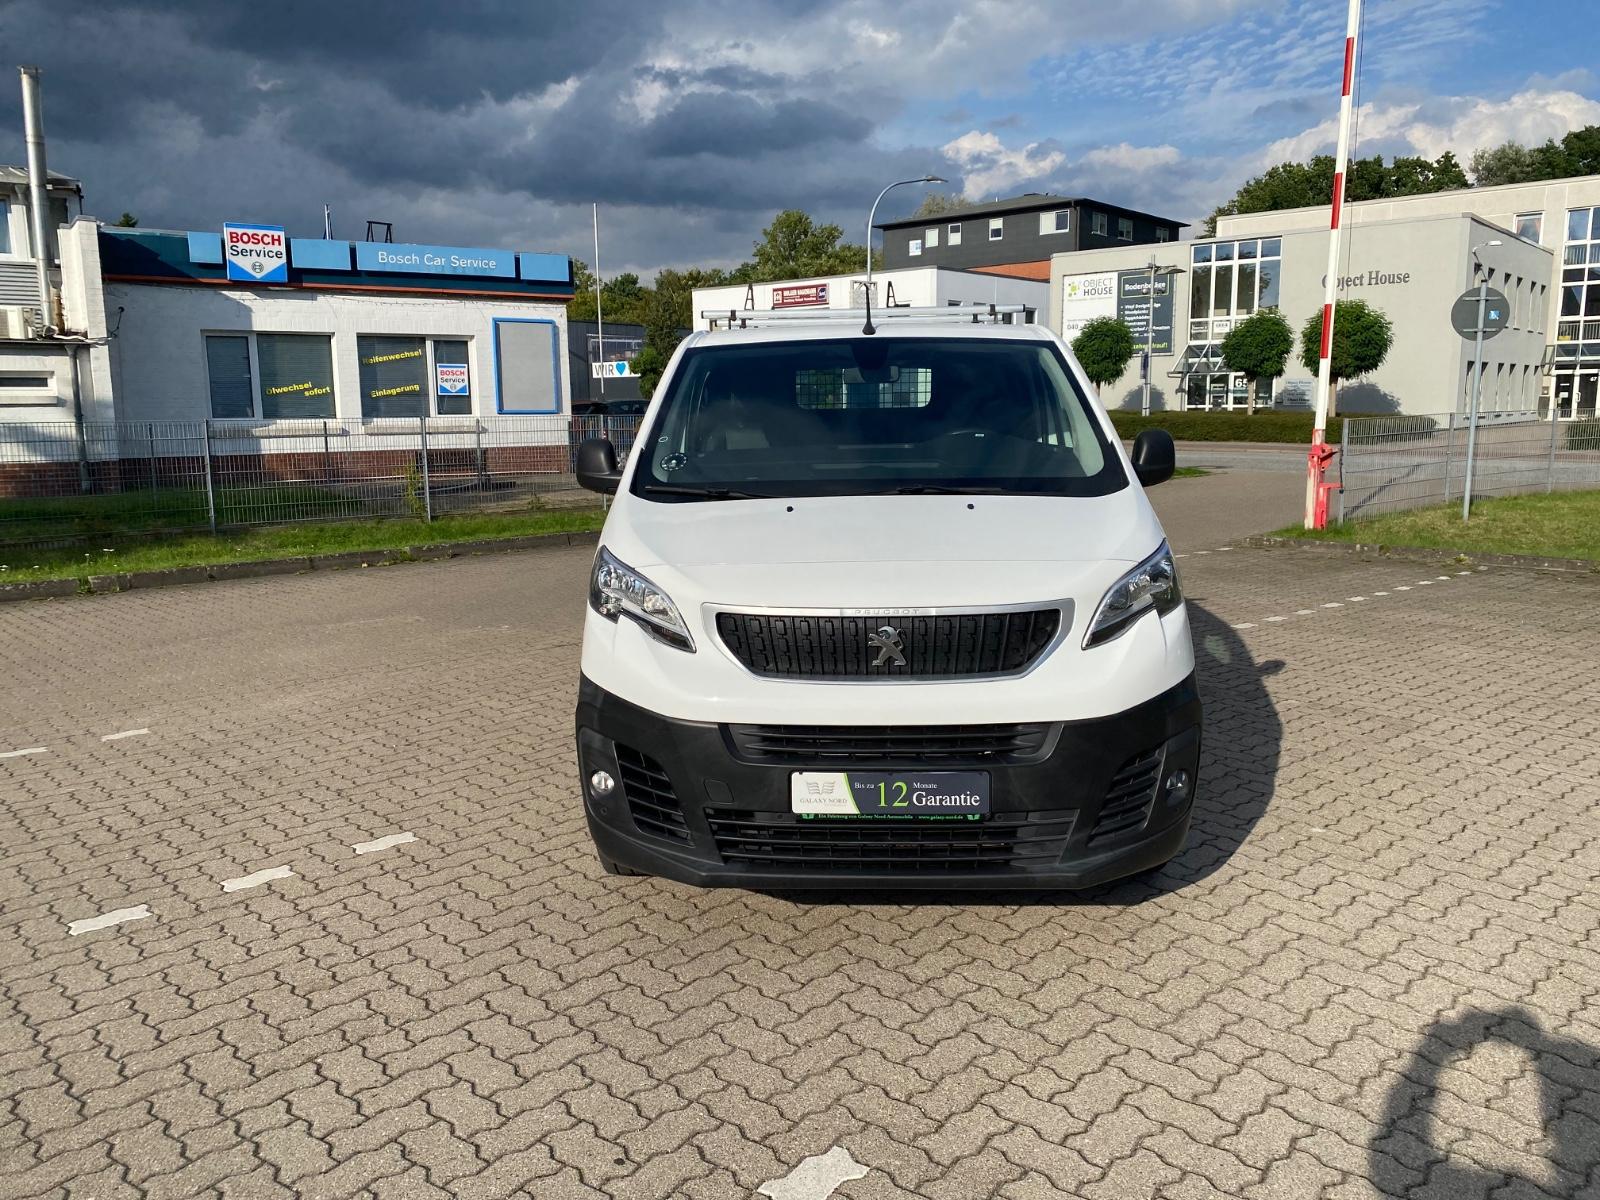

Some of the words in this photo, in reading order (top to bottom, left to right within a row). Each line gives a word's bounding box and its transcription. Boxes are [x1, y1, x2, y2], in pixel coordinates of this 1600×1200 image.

[229, 231, 282, 246] BOSCH
[230, 245, 283, 259] Service
[378, 251, 420, 264] Bosch
[424, 254, 446, 266] Car
[450, 255, 497, 269] Service
[1083, 278, 1113, 289] OBJECT
[1367, 270, 1410, 286] House
[1083, 286, 1113, 296] HOUSE
[440, 369, 465, 377] BOSCH
[594, 363, 615, 377] WIR
[440, 376, 466, 384] Service
[304, 386, 331, 397] sofort
[371, 384, 420, 398] Einlagerung
[877, 781, 909, 807] 12
[912, 791, 980, 806] Garantie
